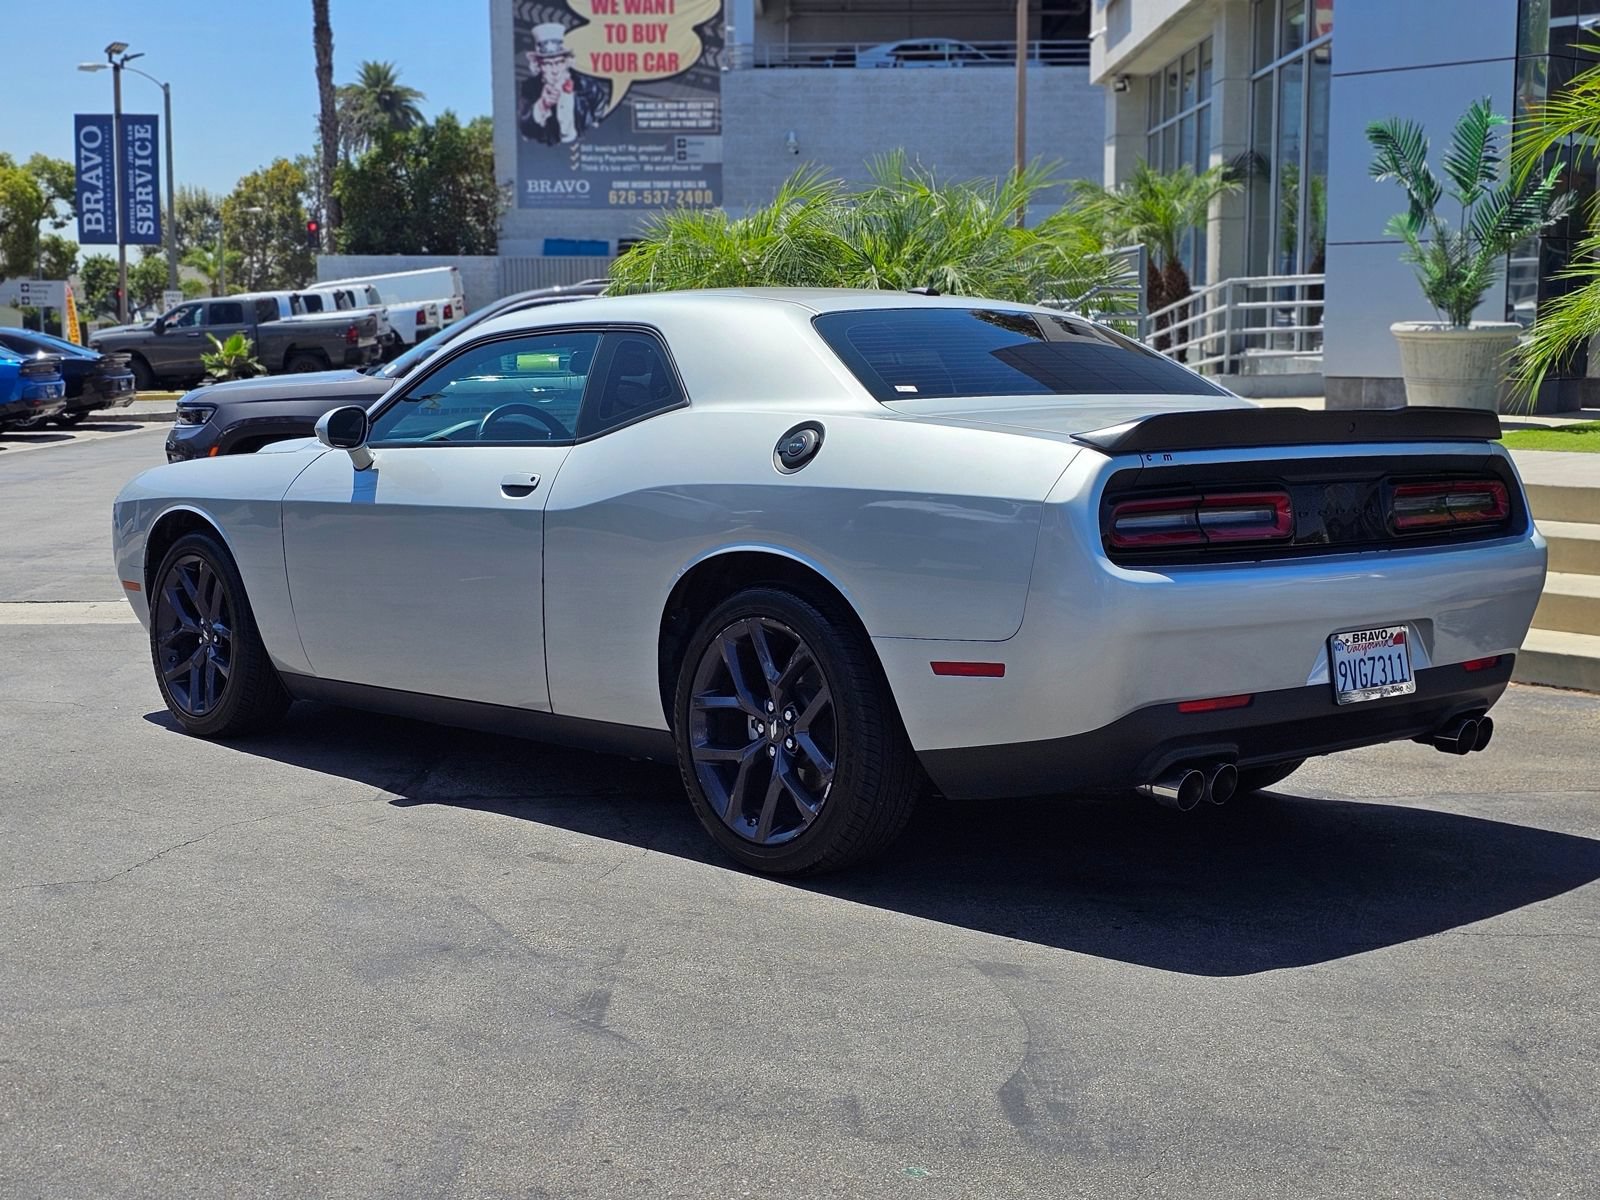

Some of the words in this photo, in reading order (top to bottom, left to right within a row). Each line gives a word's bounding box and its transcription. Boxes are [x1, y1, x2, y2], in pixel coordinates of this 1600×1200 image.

[592, 0, 619, 15] WE
[624, 0, 675, 15] WANT
[604, 24, 627, 44] TO
[632, 24, 668, 44] BUY
[590, 52, 638, 72] YOUR
[643, 52, 679, 72] CAR
[80, 125, 105, 233] BRAVO
[135, 124, 154, 235] SERVICE
[526, 180, 590, 193] BRAVO
[609, 190, 713, 204] 626-537-2400
[1352, 630, 1388, 643] BRAVO
[1338, 652, 1408, 692] 9VGZ311
